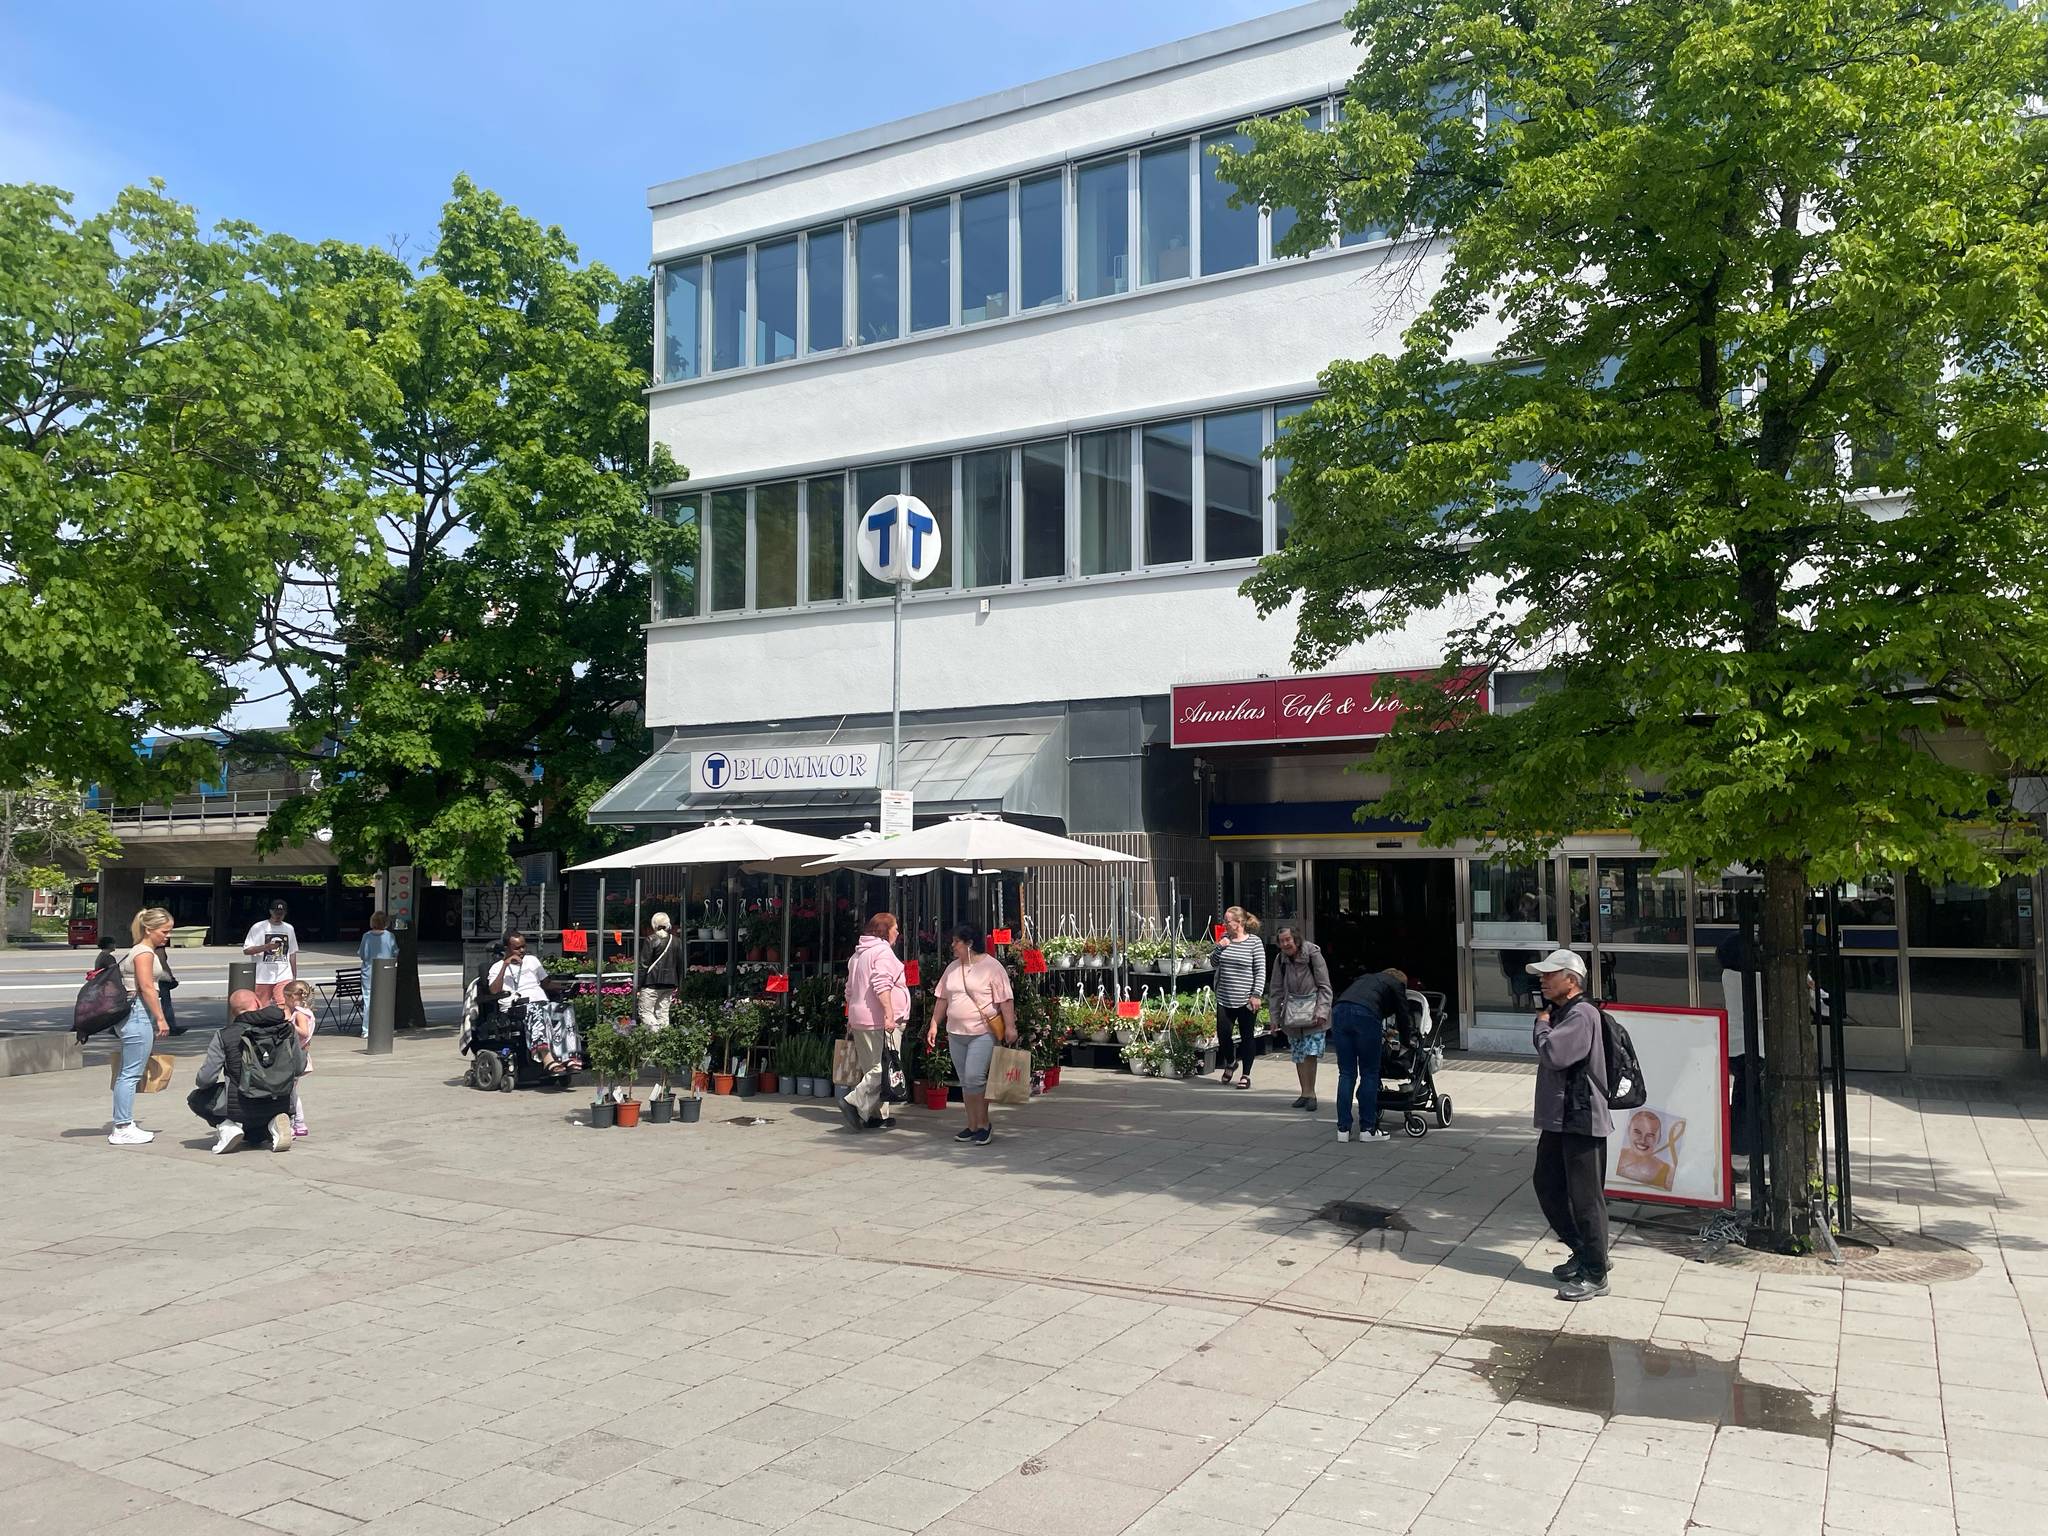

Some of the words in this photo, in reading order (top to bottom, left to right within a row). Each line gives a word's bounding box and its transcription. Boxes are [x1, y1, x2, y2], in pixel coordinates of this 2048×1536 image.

[868, 507, 897, 567] T
[907, 508, 933, 569] T
[1179, 698, 1267, 724] Annikas
[1281, 692, 1331, 724] Café
[1336, 697, 1355, 713] &
[734, 753, 867, 780] BLOMMOR
